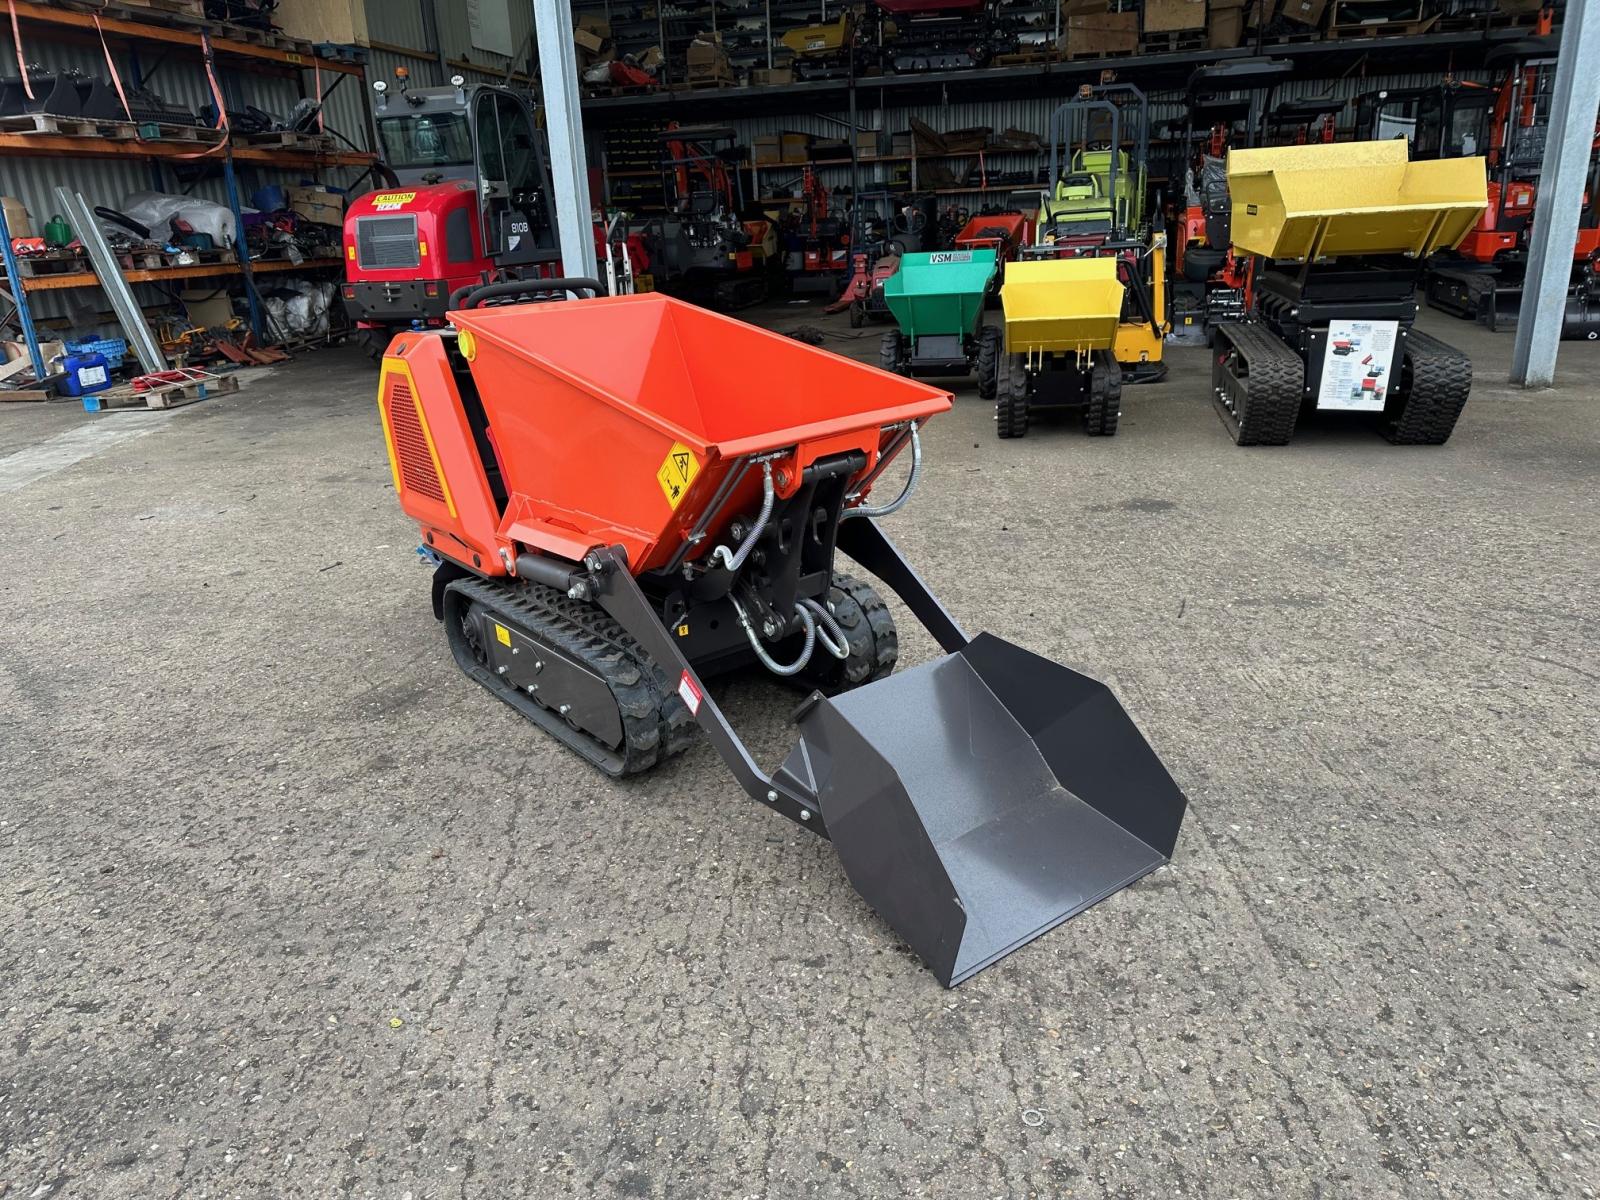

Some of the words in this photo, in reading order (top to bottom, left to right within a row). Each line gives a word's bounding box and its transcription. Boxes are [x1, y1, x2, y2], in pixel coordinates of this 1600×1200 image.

[377, 193, 414, 202] CAUTION
[511, 222, 529, 233] 810B
[931, 253, 952, 263] VSM
